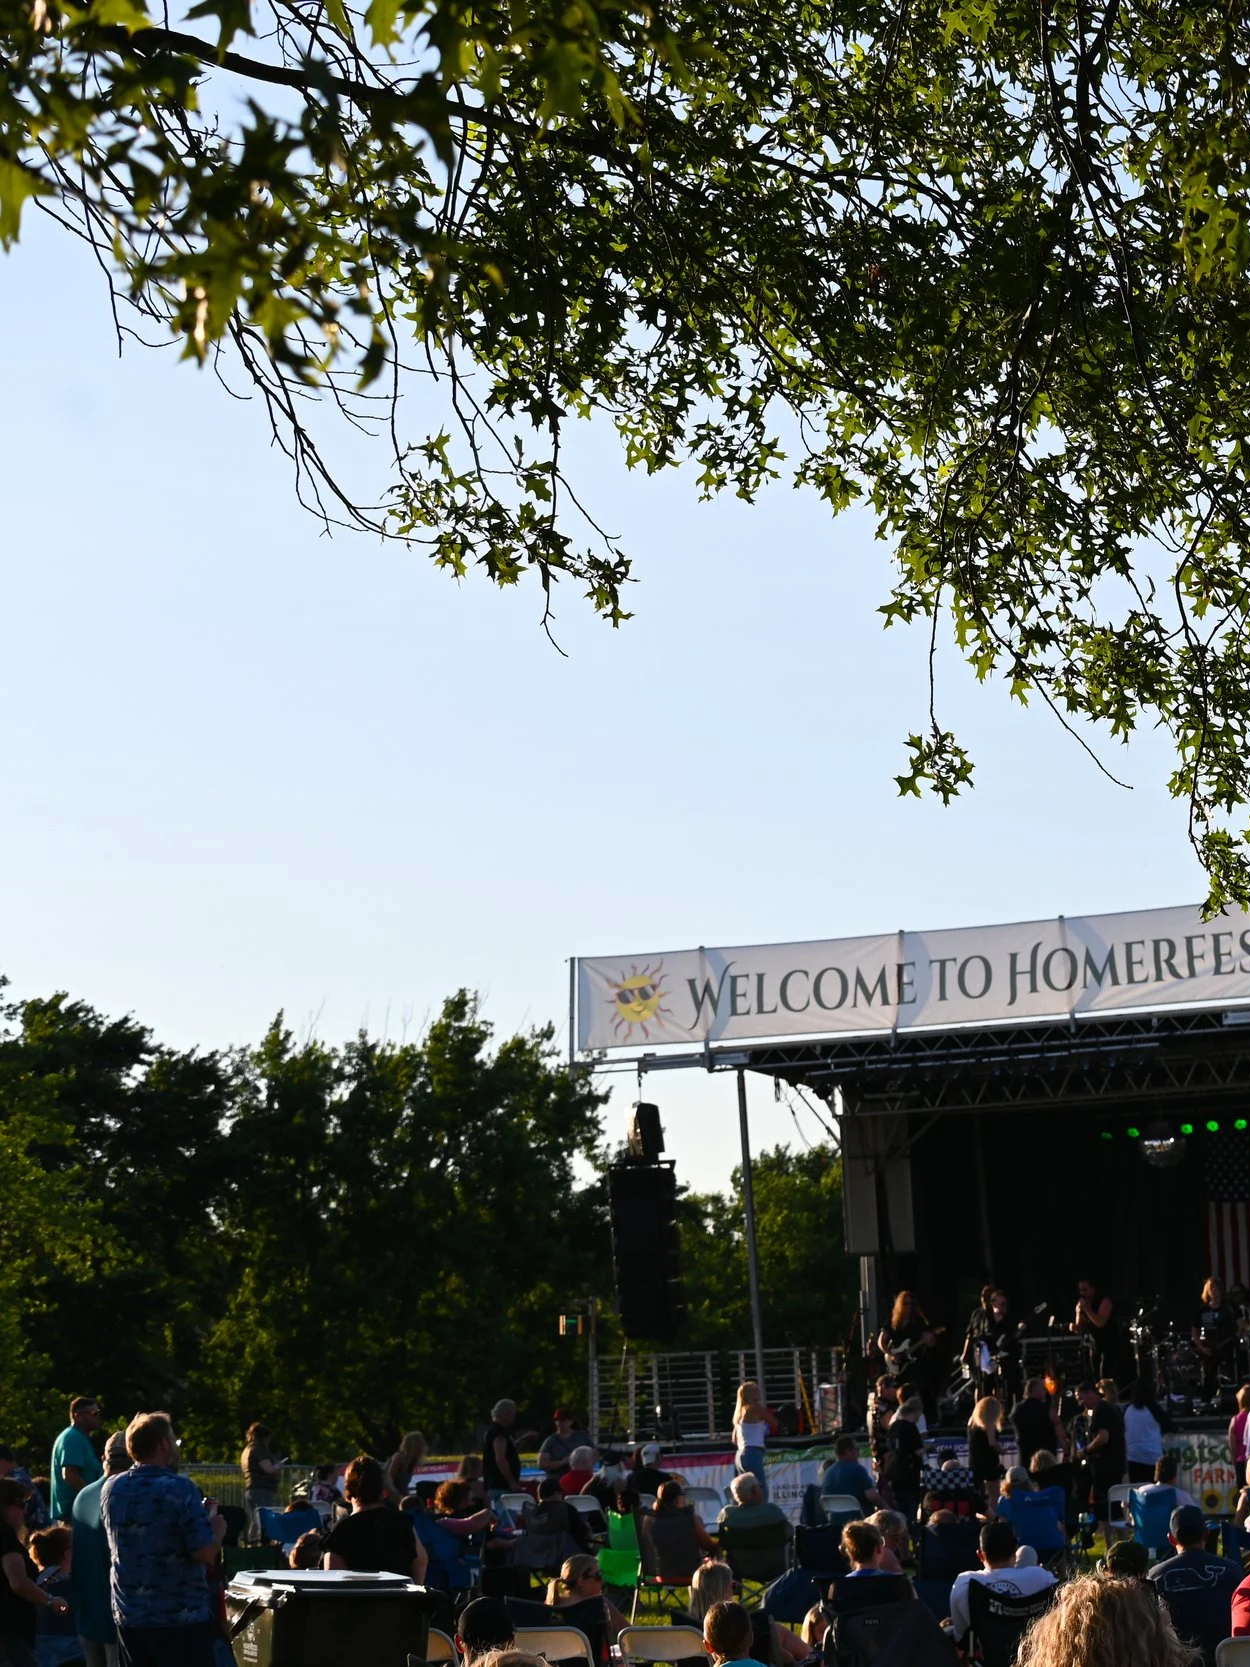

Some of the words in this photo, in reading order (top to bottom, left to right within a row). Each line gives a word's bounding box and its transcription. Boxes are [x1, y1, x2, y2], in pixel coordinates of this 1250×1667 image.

[686, 961, 917, 1030] WELCOME
[929, 955, 992, 1001] TO
[773, 1490, 806, 1499] ILLINO
